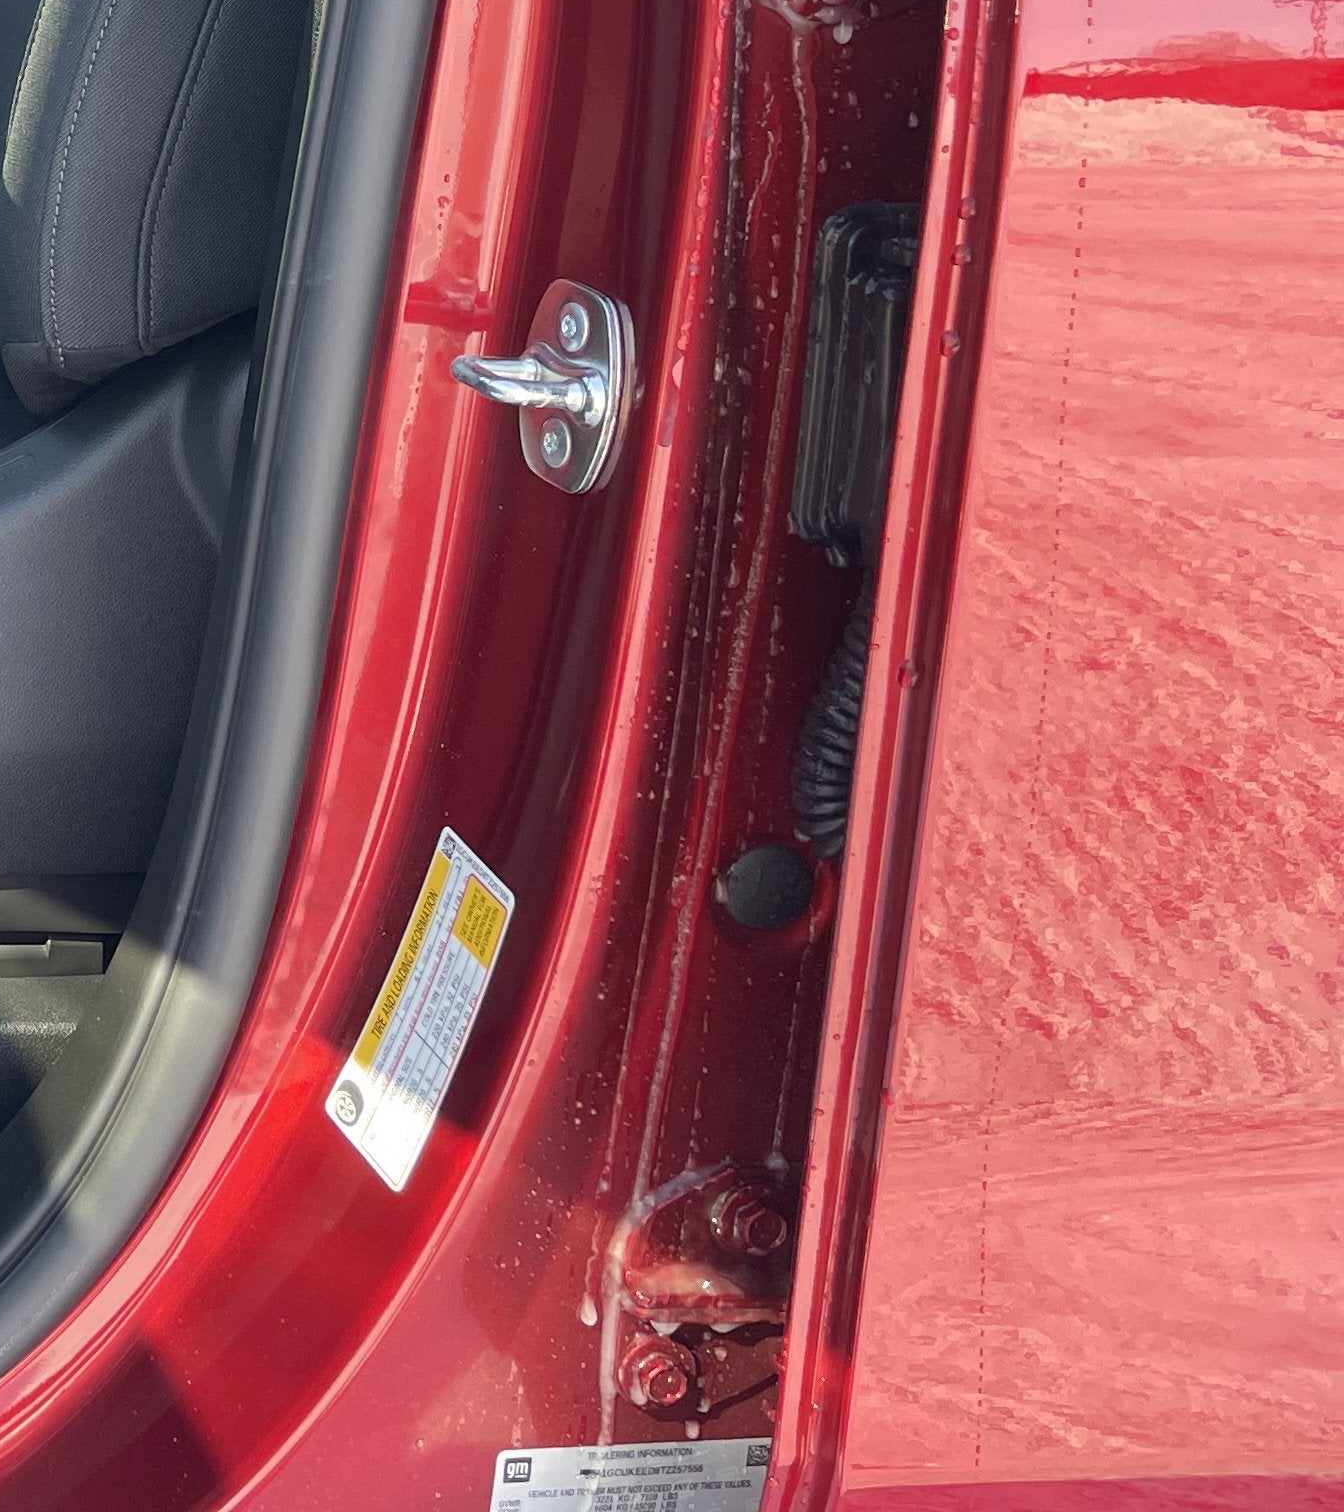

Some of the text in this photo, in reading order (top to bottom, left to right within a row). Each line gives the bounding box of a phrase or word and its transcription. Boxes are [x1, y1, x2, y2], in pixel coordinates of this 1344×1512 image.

[372, 1015, 387, 1041] TIRE
[381, 993, 396, 1018] AND
[393, 954, 415, 1003] LOADING
[408, 889, 438, 956] INFORMATION
[637, 1448, 693, 1458] INFORMATION
[506, 1462, 529, 1479] gm
[606, 1486, 627, 1494] MUST
[628, 1485, 643, 1494] NOT
[644, 1484, 672, 1492] EXCEED
[673, 1483, 688, 1491] ANY
[689, 1482, 699, 1490] OF
